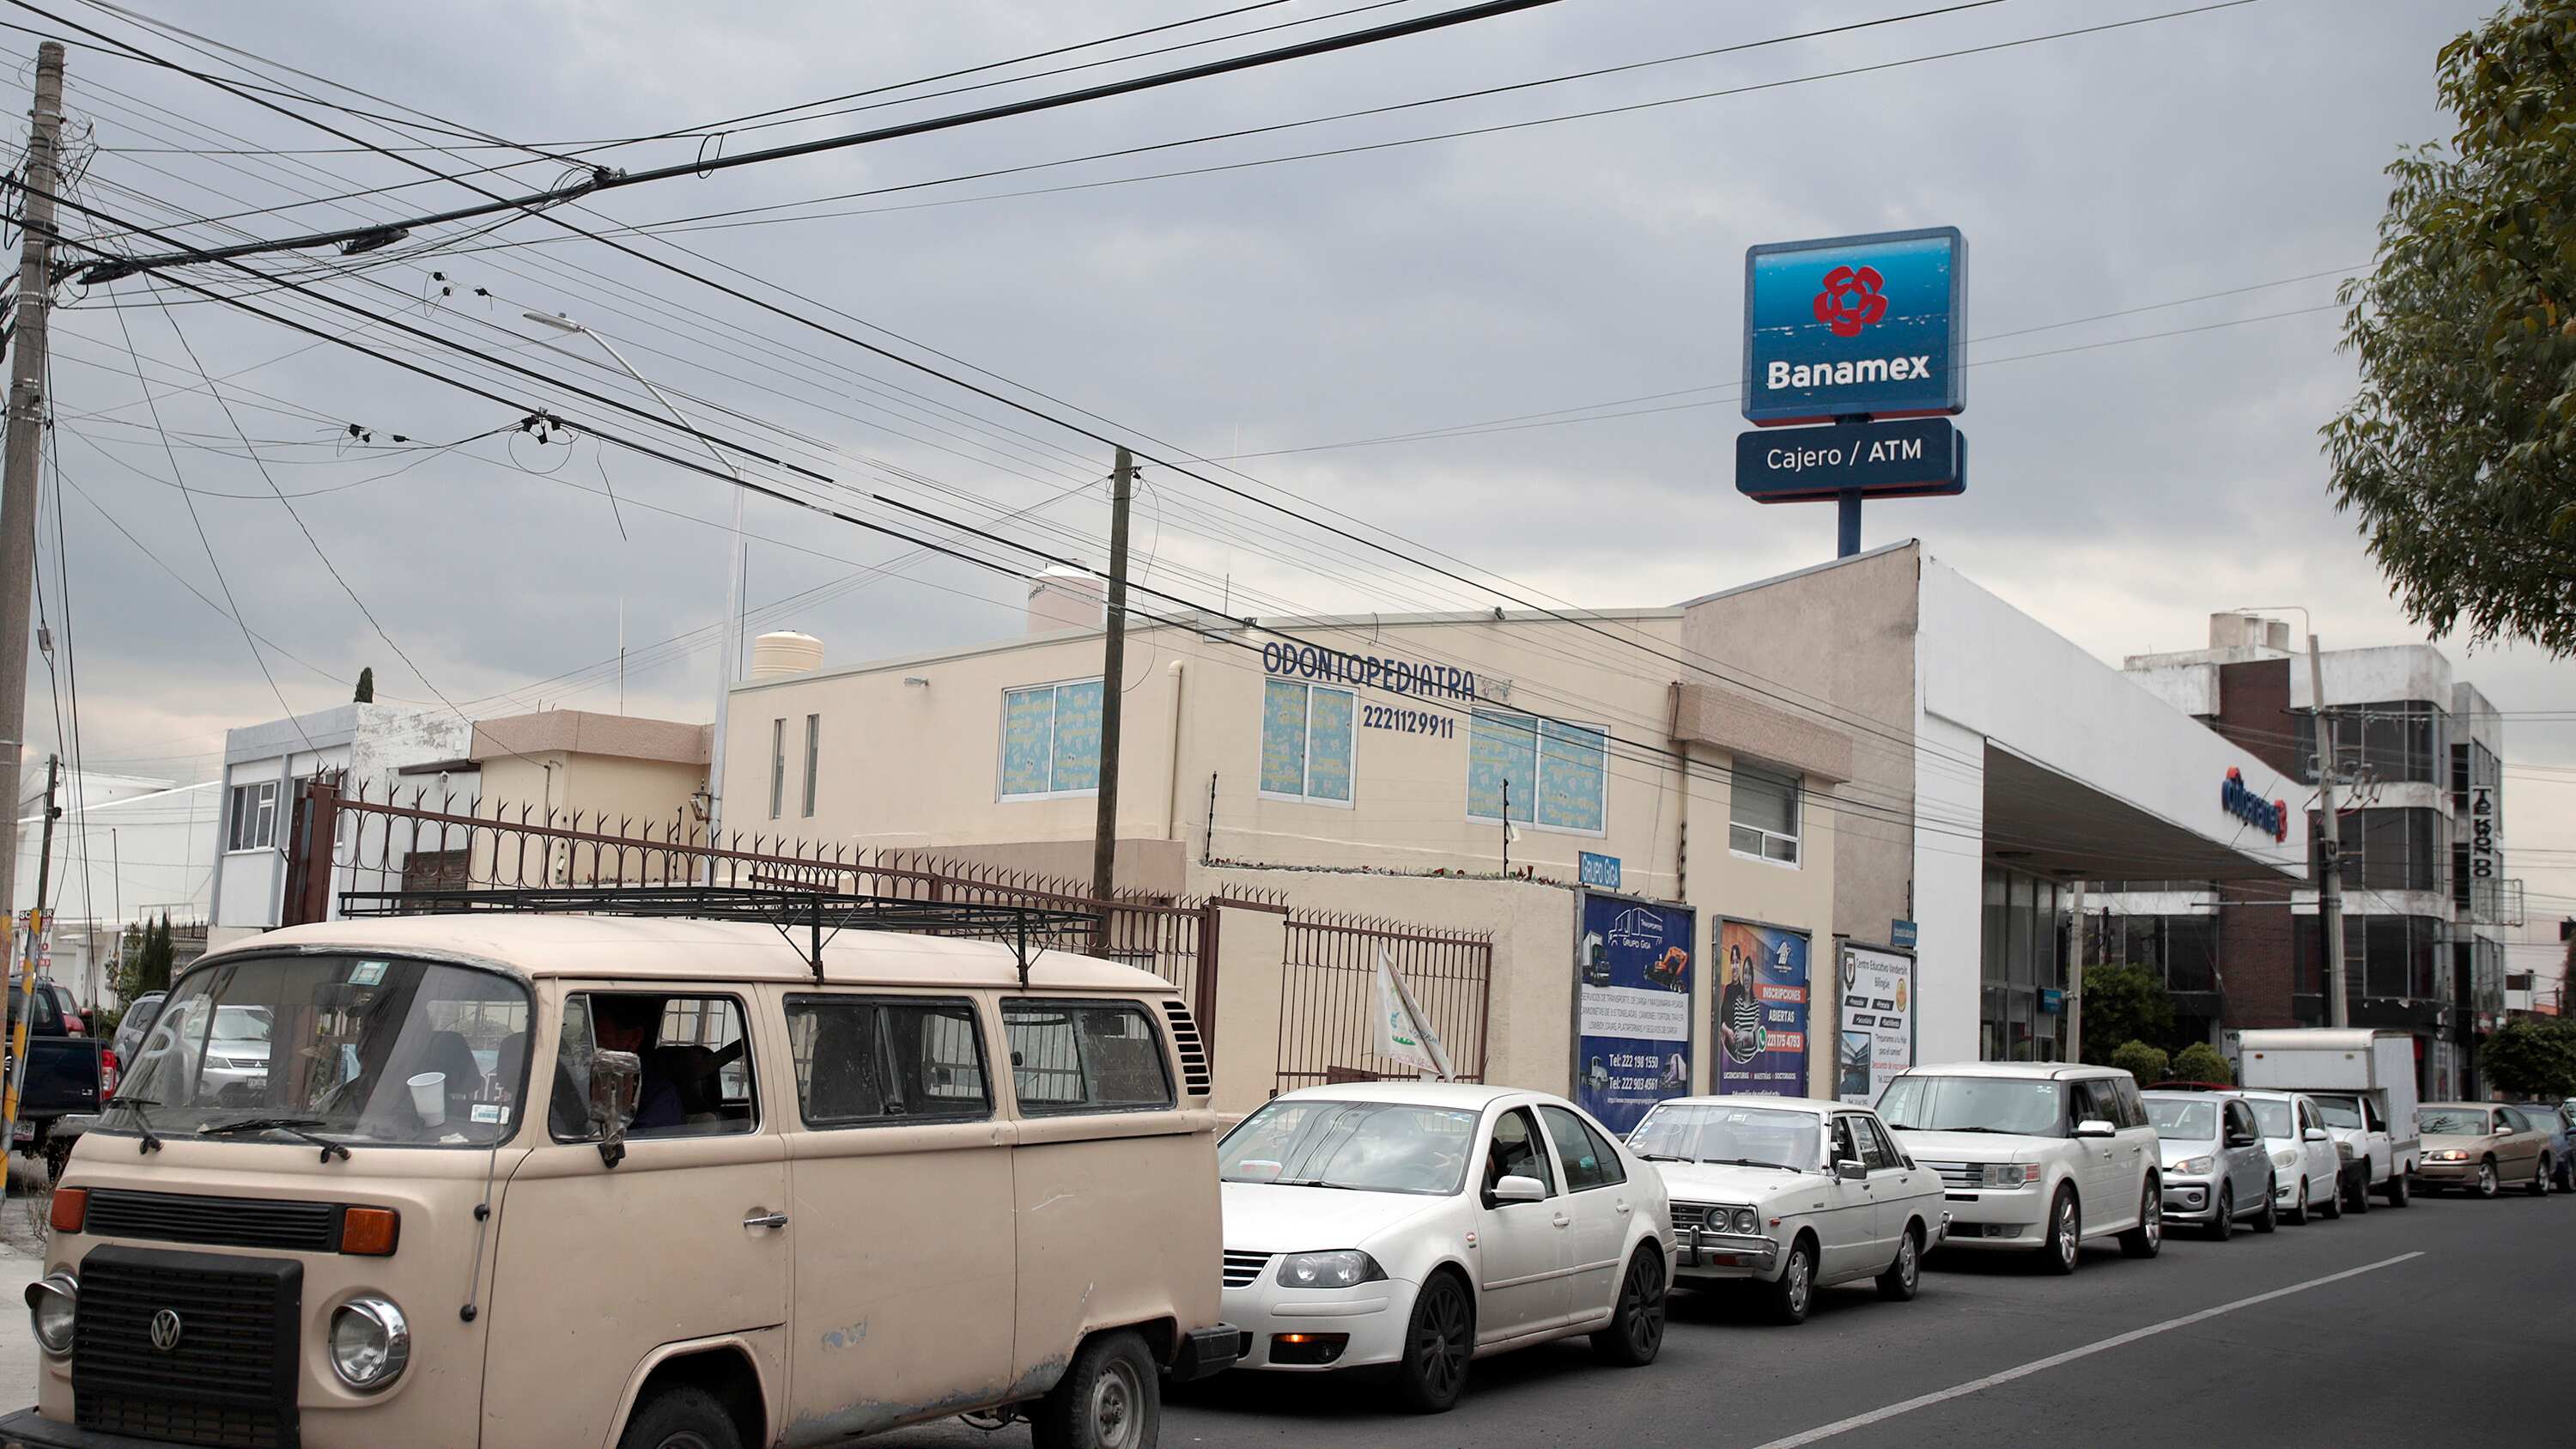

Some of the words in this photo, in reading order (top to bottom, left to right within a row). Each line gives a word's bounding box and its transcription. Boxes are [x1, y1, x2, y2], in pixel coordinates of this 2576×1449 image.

[1768, 356, 1930, 389] Banamex
[1767, 447, 1841, 472] Cajero
[1850, 441, 1860, 466] /
[1868, 439, 1922, 463] ATM
[1263, 642, 1475, 702] ODONTOPEDIATRA
[1364, 705, 1454, 739] 2221129911
[1763, 987, 1801, 1002] INSCRIPCIONES
[1769, 1009, 1795, 1023] ABIERTAS
[1621, 1054, 1633, 1068] 222
[1621, 1077, 1633, 1090] 222
